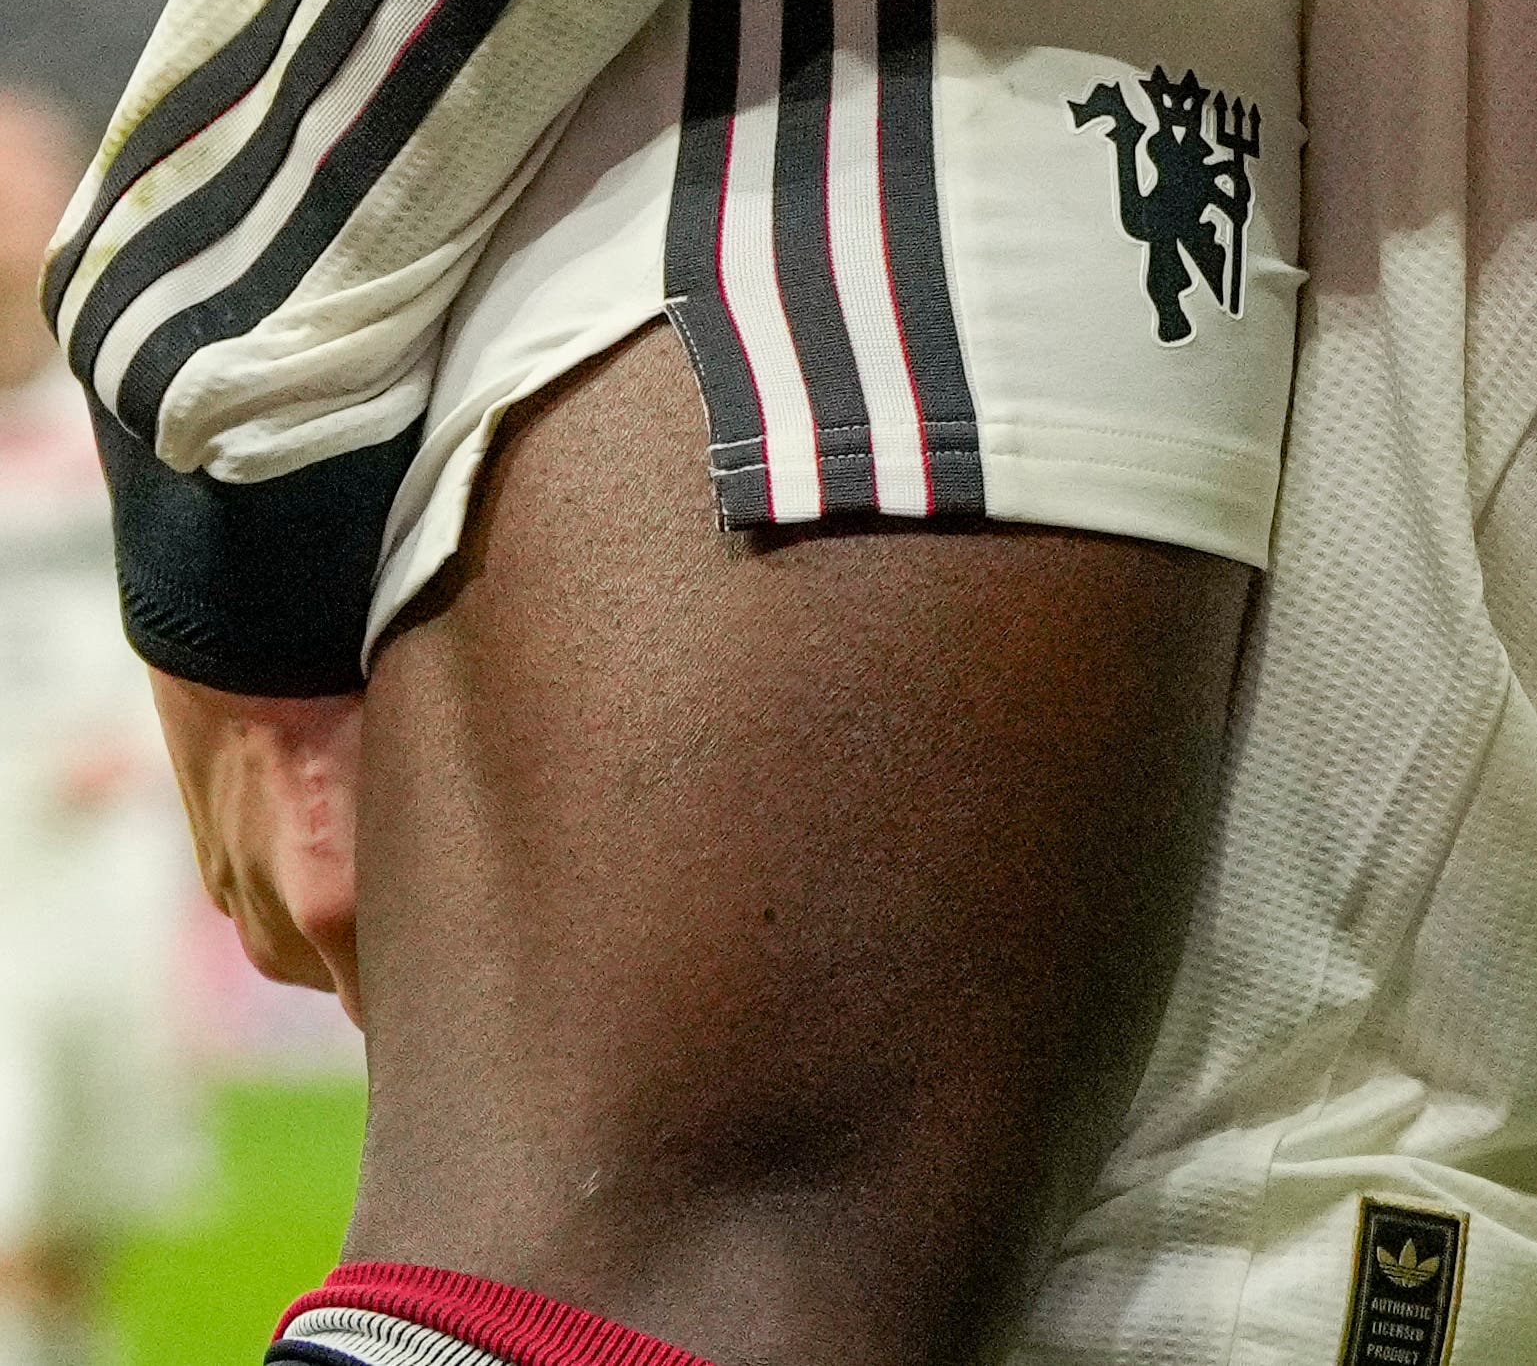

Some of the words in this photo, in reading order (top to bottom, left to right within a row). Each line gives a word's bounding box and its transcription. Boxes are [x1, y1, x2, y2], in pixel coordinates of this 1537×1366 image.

[1371, 1296, 1432, 1321] AUTHENTIC
[1371, 1321, 1425, 1342] LICENSED
[1366, 1343, 1420, 1366] PRODUCT
